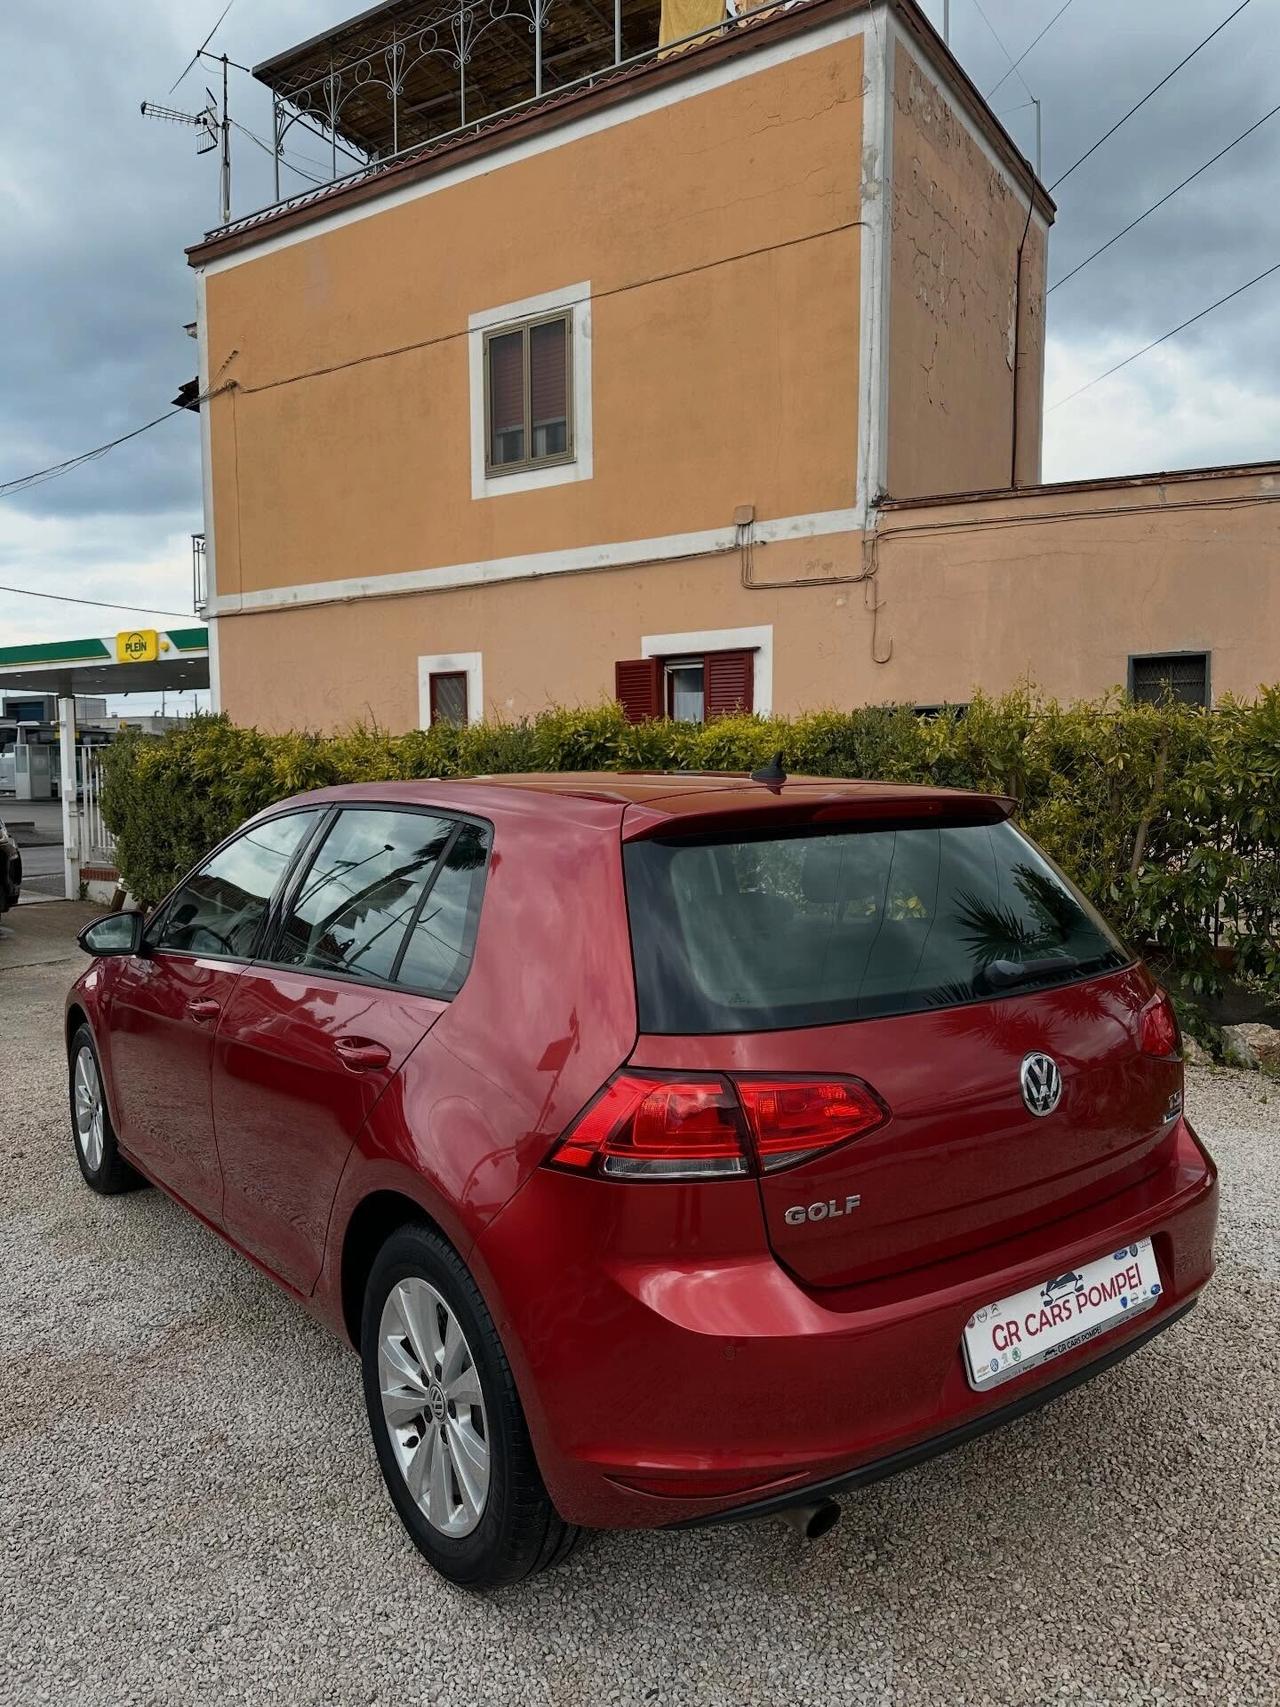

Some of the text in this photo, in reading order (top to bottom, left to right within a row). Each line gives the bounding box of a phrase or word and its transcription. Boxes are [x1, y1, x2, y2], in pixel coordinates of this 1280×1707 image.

[125, 640, 147, 653] PLEIN
[784, 1194, 862, 1225] GOLF
[992, 1319, 1022, 1351] GR
[1024, 1299, 1073, 1337] CARS
[1075, 1262, 1143, 1314] POMPEI
[1067, 1336, 1082, 1349] CARS
